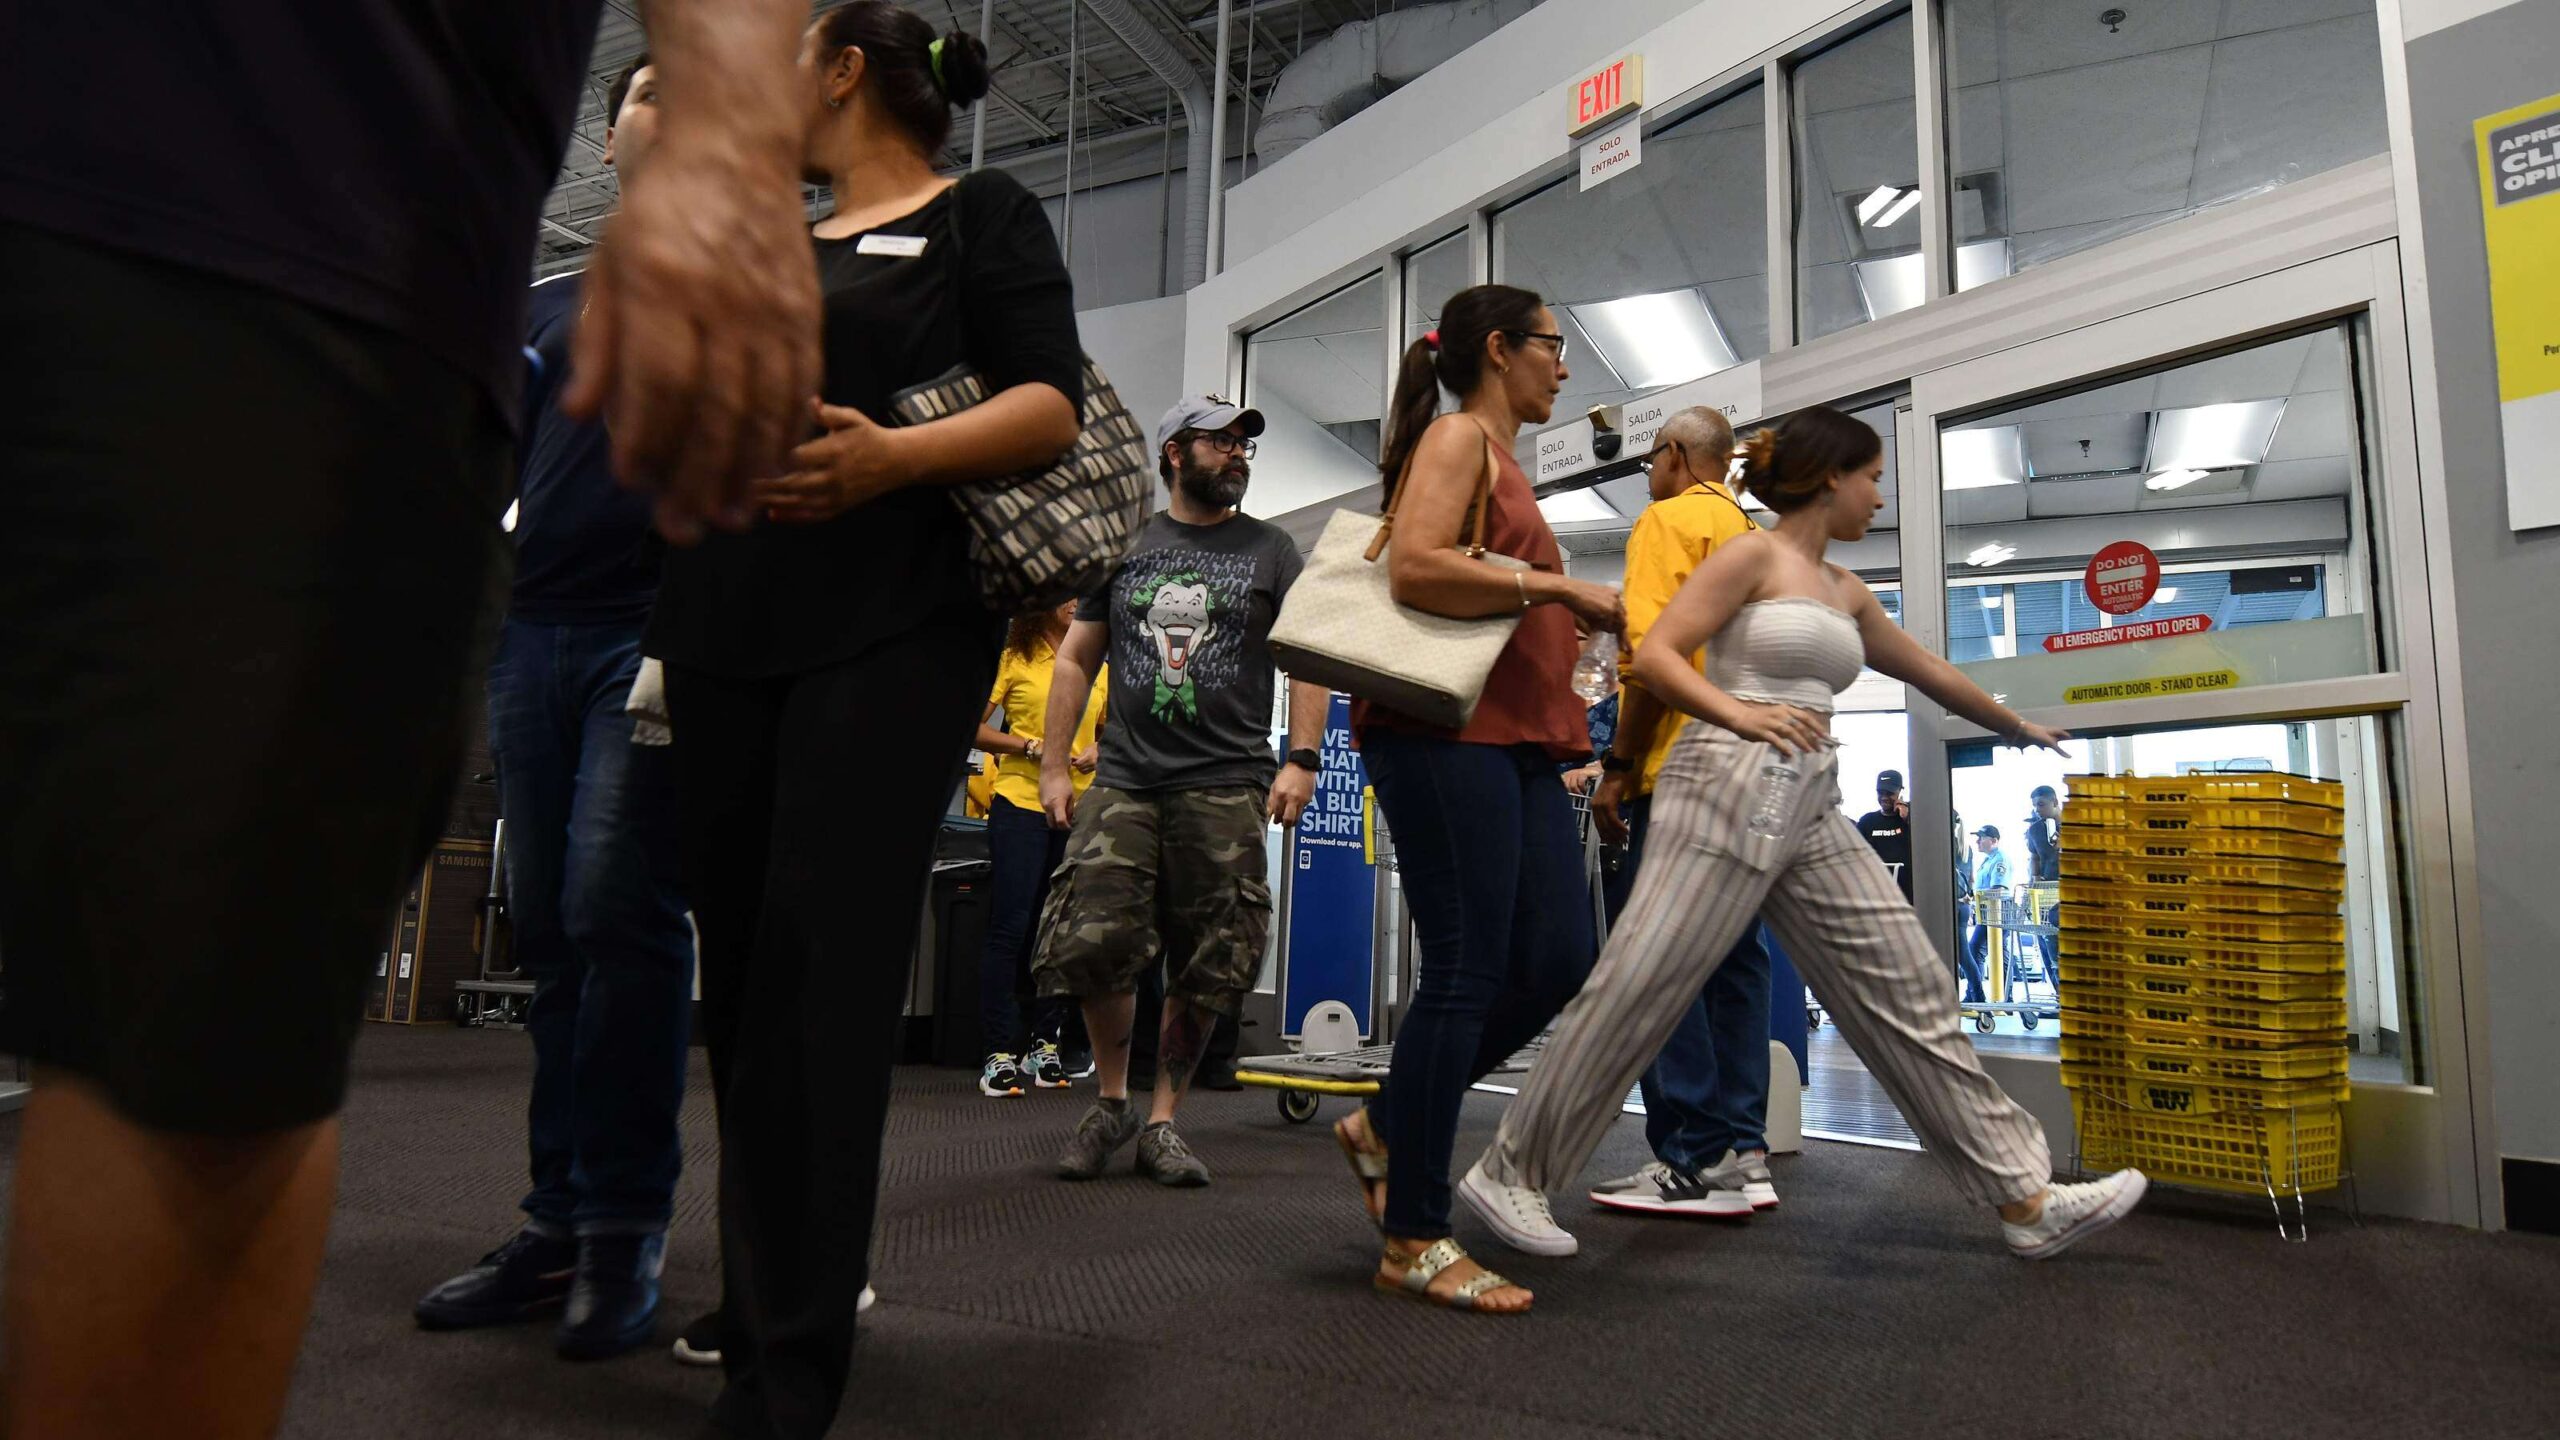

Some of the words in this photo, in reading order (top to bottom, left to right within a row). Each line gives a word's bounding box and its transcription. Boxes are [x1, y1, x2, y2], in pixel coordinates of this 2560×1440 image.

[1579, 61, 1623, 124] EXIT
[1599, 136, 1621, 154] SOLO
[1591, 149, 1630, 175] ENTRADA
[2503, 164, 2560, 191] OPI
[1628, 408, 1663, 427] SALIDA
[1628, 427, 1662, 446] PROXI
[1541, 440, 1565, 456] SOLO
[1542, 453, 1583, 475] ENTRADA
[2096, 559, 2114, 571] DO
[2118, 554, 2144, 566] NOT
[2100, 580, 2144, 596] ENTER
[2053, 637, 2064, 649] IN
[2065, 627, 2123, 647] EMERGENCY
[2126, 624, 2153, 639] PUSH
[2156, 621, 2169, 635] TO
[2173, 617, 2200, 633] OPEN
[2071, 685, 2123, 701] AUTOMATIC
[2126, 682, 2152, 695] DOOR
[2161, 678, 2193, 692] STAND
[2196, 674, 2228, 687] CLEAR
[1324, 728, 1349, 748] VE
[1319, 749, 1361, 771] HAT
[1327, 792, 1364, 813] BLU
[2146, 793, 2187, 802] BEST
[1301, 811, 1362, 835] SHIRT
[2148, 820, 2188, 829] BEST
[1300, 836, 1336, 846] Download
[1348, 841, 1363, 849] app.
[2145, 847, 2187, 856] BEST
[2147, 874, 2188, 884] BEST
[2145, 901, 2187, 911] BEST
[2145, 928, 2187, 938] BEST
[2146, 953, 2187, 965] BEST
[2146, 981, 2187, 993] BEST
[2147, 1008, 2188, 1022] BEST
[2147, 1060, 2189, 1073] BEST
[2149, 1088, 2190, 1101] BEST
[2152, 1099, 2190, 1112] BUY
